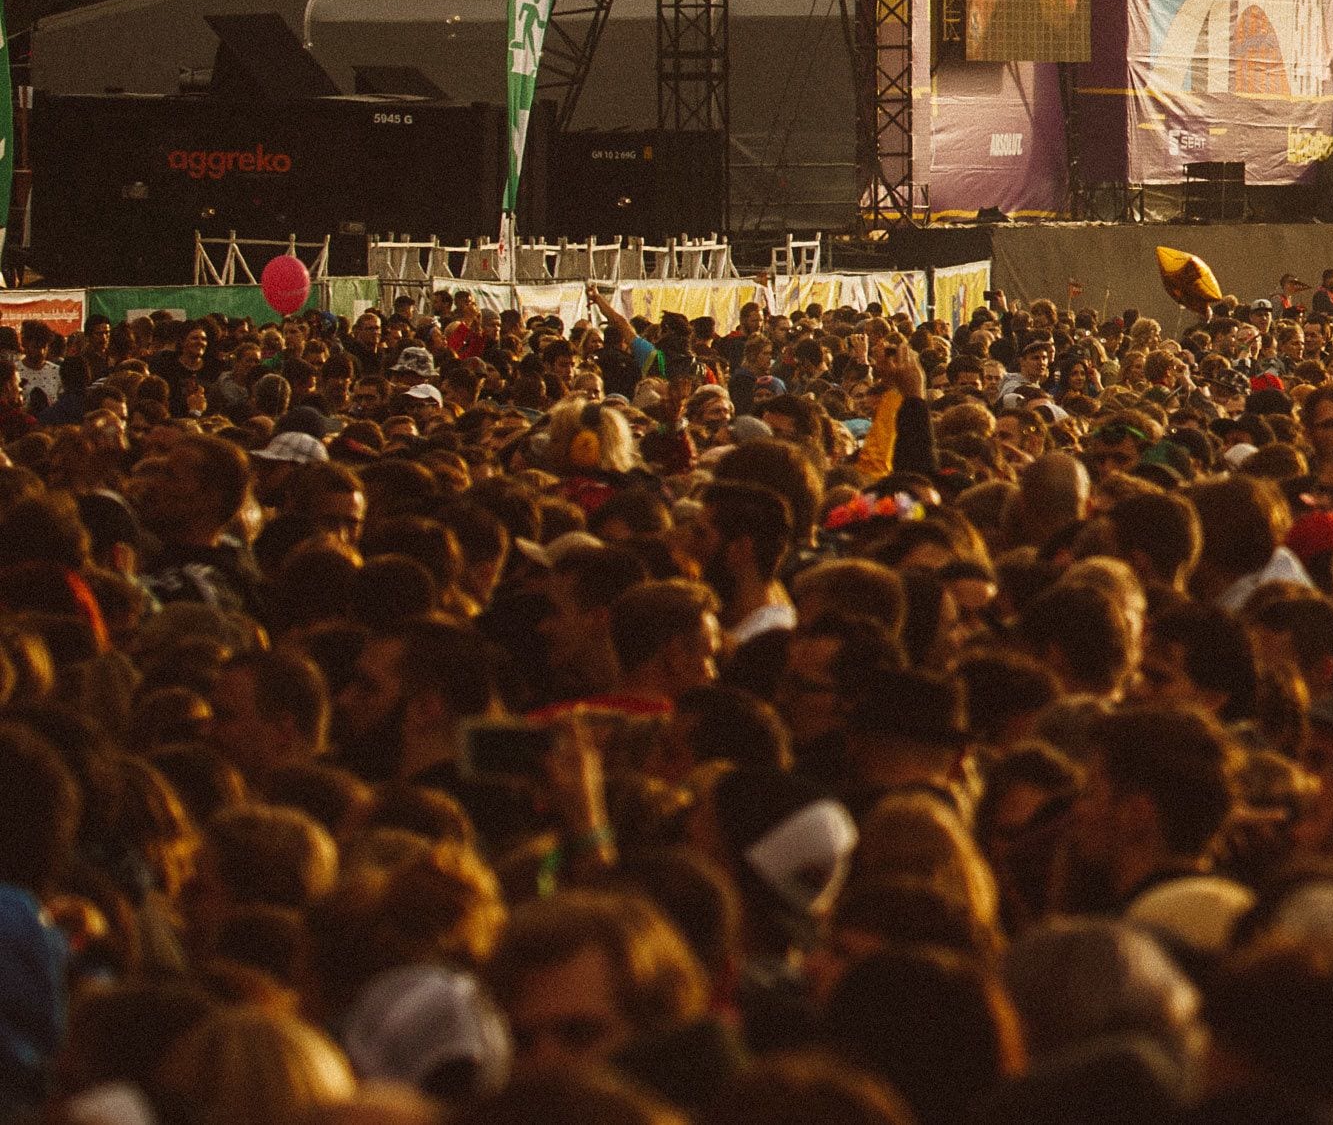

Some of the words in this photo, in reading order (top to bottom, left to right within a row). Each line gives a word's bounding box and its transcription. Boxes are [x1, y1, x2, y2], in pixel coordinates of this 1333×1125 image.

[403, 114, 414, 125] G
[1180, 136, 1207, 149] SEAT
[168, 142, 292, 179] aggreko
